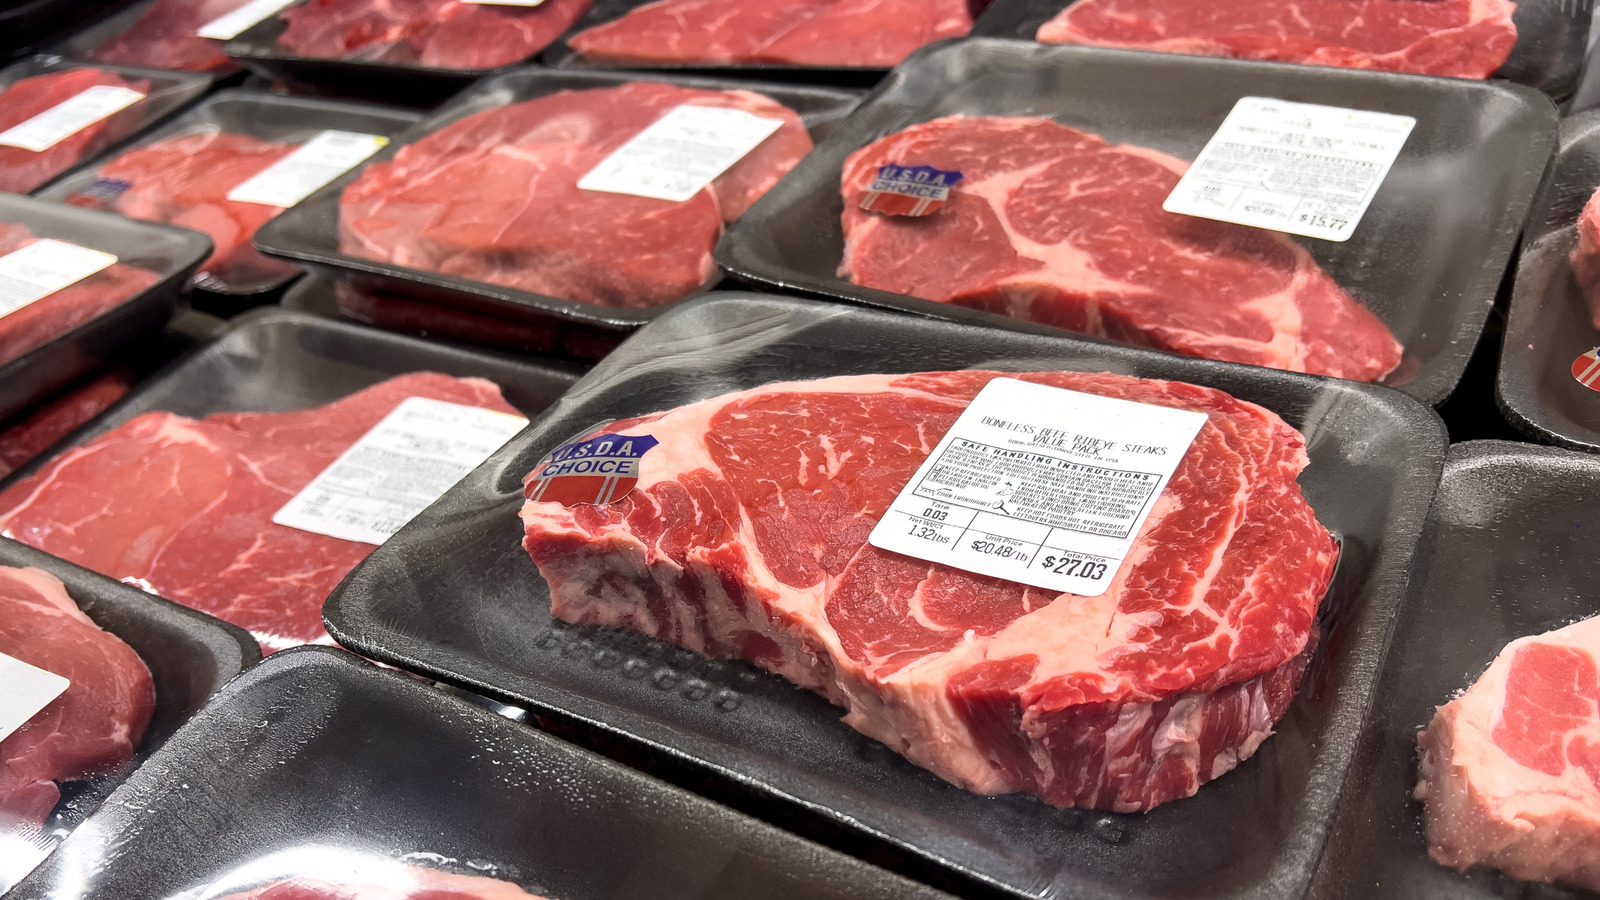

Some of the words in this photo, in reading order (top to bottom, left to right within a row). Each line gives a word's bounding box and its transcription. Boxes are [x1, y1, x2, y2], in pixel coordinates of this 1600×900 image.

[872, 181, 943, 199] CHOICE
[981, 416, 1036, 434] BONELESS
[1039, 427, 1069, 439] BEEF
[1073, 434, 1118, 450] RIBEYE
[1122, 444, 1168, 456] STEAKS
[1033, 435, 1068, 448] VALUE
[1071, 443, 1102, 456] PACK
[554, 440, 637, 461] U.S.D.A.
[542, 460, 634, 477] CHOICE
[962, 441, 988, 452] SAFE
[993, 449, 1052, 465] HANDLING
[1057, 461, 1150, 480] INSTRUCTIONS
[923, 508, 948, 521] 0.03
[932, 502, 950, 510] Tare
[908, 516, 922, 524] Net
[908, 524, 950, 544] 1.32lbs
[985, 534, 1002, 543] Unit
[1003, 538, 1023, 546] Price
[971, 540, 1028, 561] $20.48/lb
[1063, 550, 1083, 559] Total
[1084, 554, 1106, 563] Price
[1042, 555, 1108, 580] $27.03
